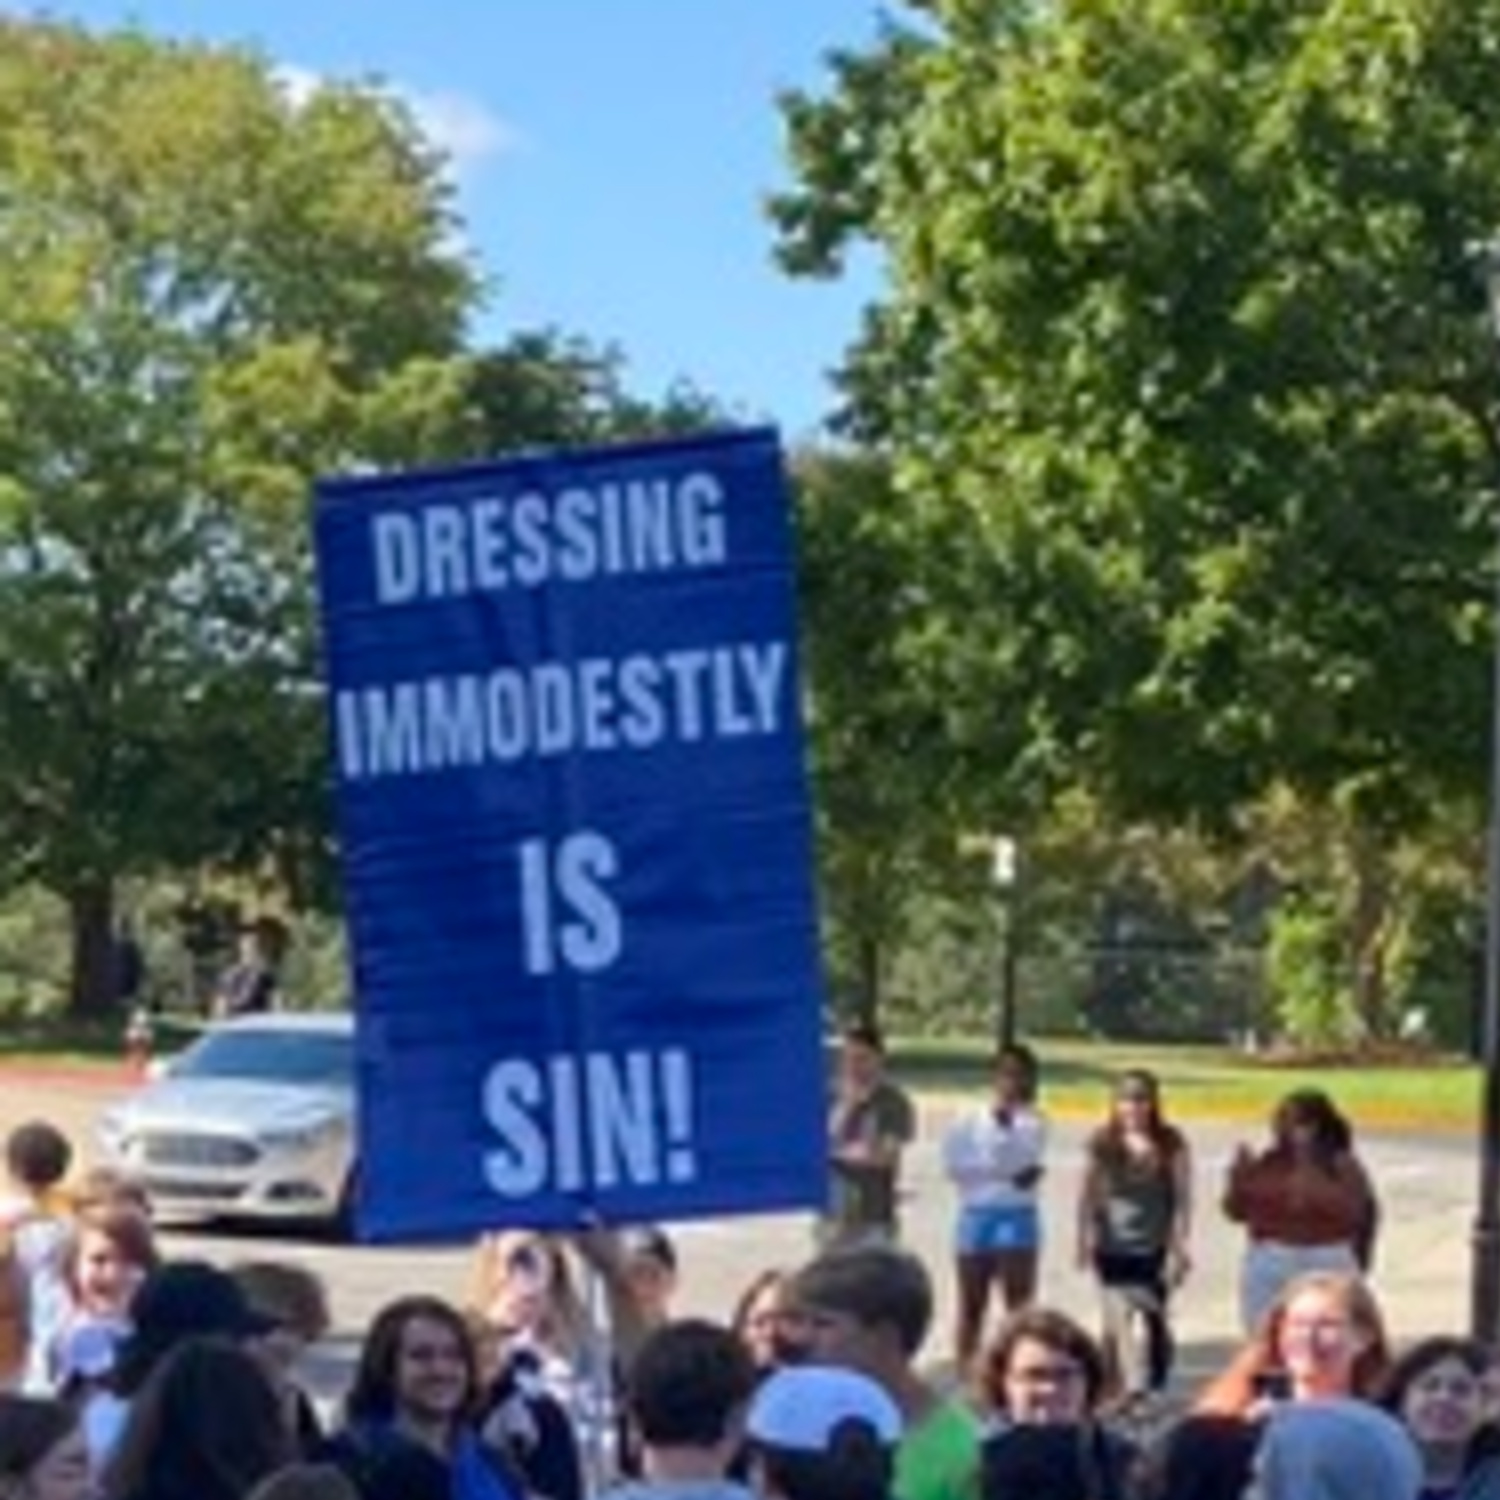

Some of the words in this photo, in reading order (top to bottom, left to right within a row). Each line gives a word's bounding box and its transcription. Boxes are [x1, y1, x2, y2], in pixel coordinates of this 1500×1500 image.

[371, 473, 726, 604] DRESSING
[337, 642, 787, 778] IMMODESTLY
[520, 830, 623, 975] IS
[482, 1047, 695, 1198] SIN!
